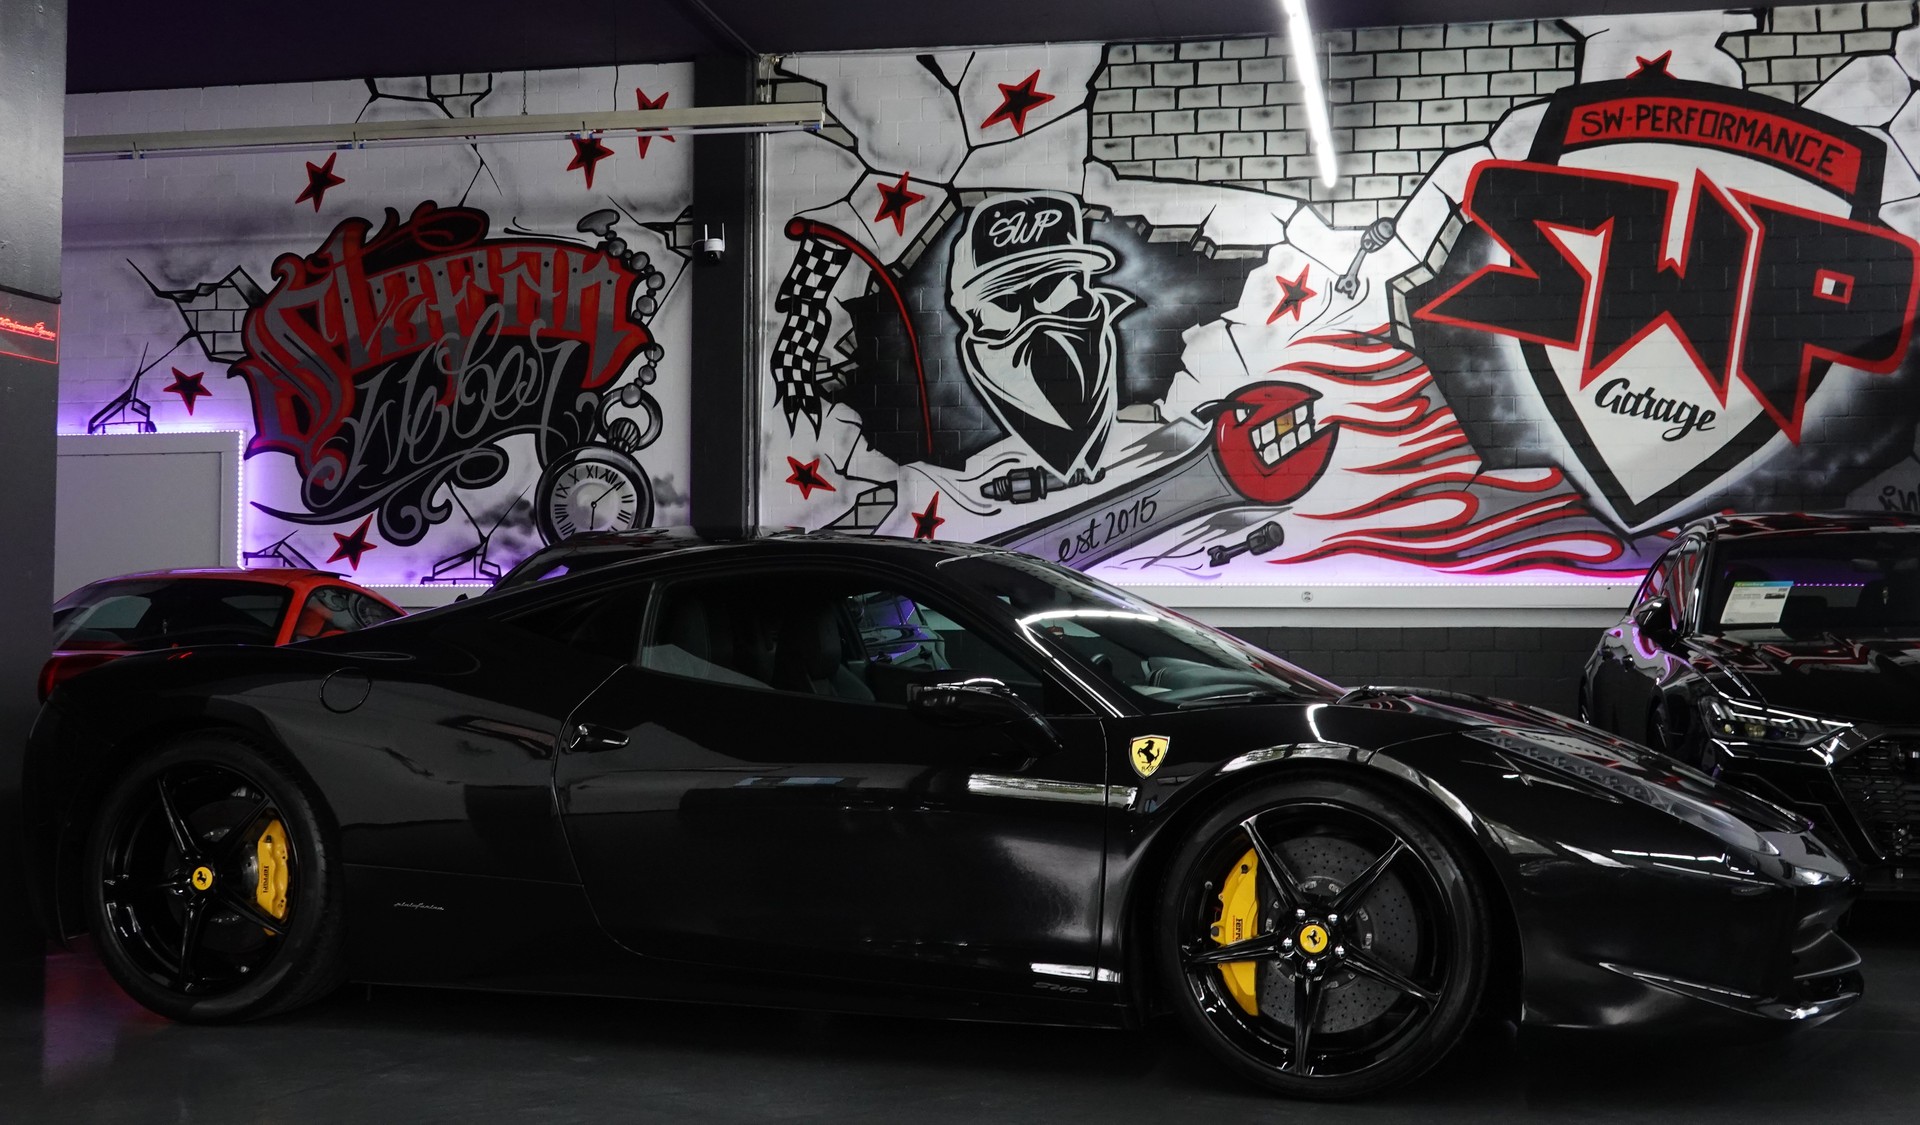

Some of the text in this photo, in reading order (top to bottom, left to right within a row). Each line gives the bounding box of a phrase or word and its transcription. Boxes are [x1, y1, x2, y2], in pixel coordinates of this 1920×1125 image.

[1581, 105, 1848, 177] SW-PERFORMANCE
[988, 208, 1062, 248] SWP
[1413, 159, 1920, 447] SWP
[308, 304, 583, 505] Weber
[1593, 377, 1717, 441] Garage
[1057, 490, 1159, 562] est 2015
